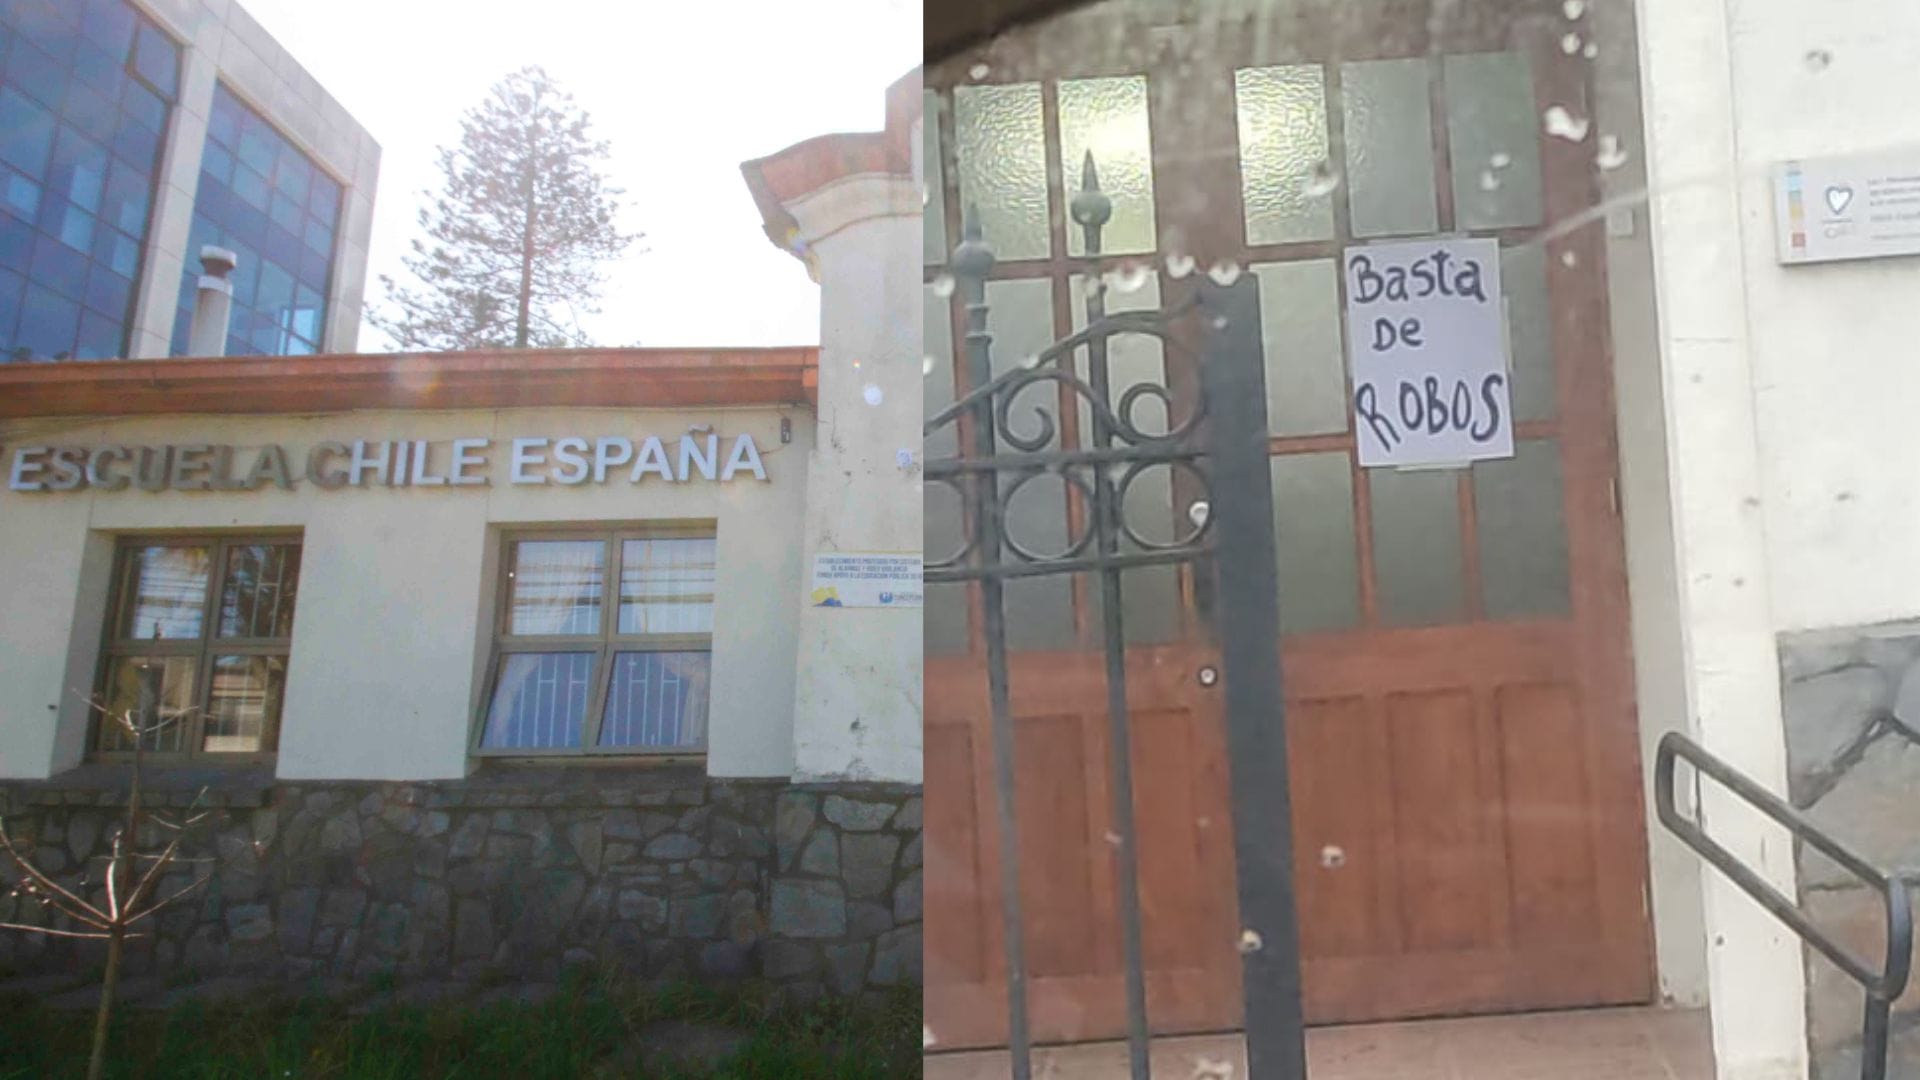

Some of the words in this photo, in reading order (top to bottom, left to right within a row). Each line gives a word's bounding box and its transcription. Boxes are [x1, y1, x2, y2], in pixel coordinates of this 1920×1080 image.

[1349, 250, 1486, 303] Basta
[1373, 317, 1422, 351] De
[1356, 373, 1503, 452] ROBOS
[8, 443, 295, 492] ESCUELA
[305, 438, 492, 488] CHILE
[510, 424, 768, 484] ESPAÑA
